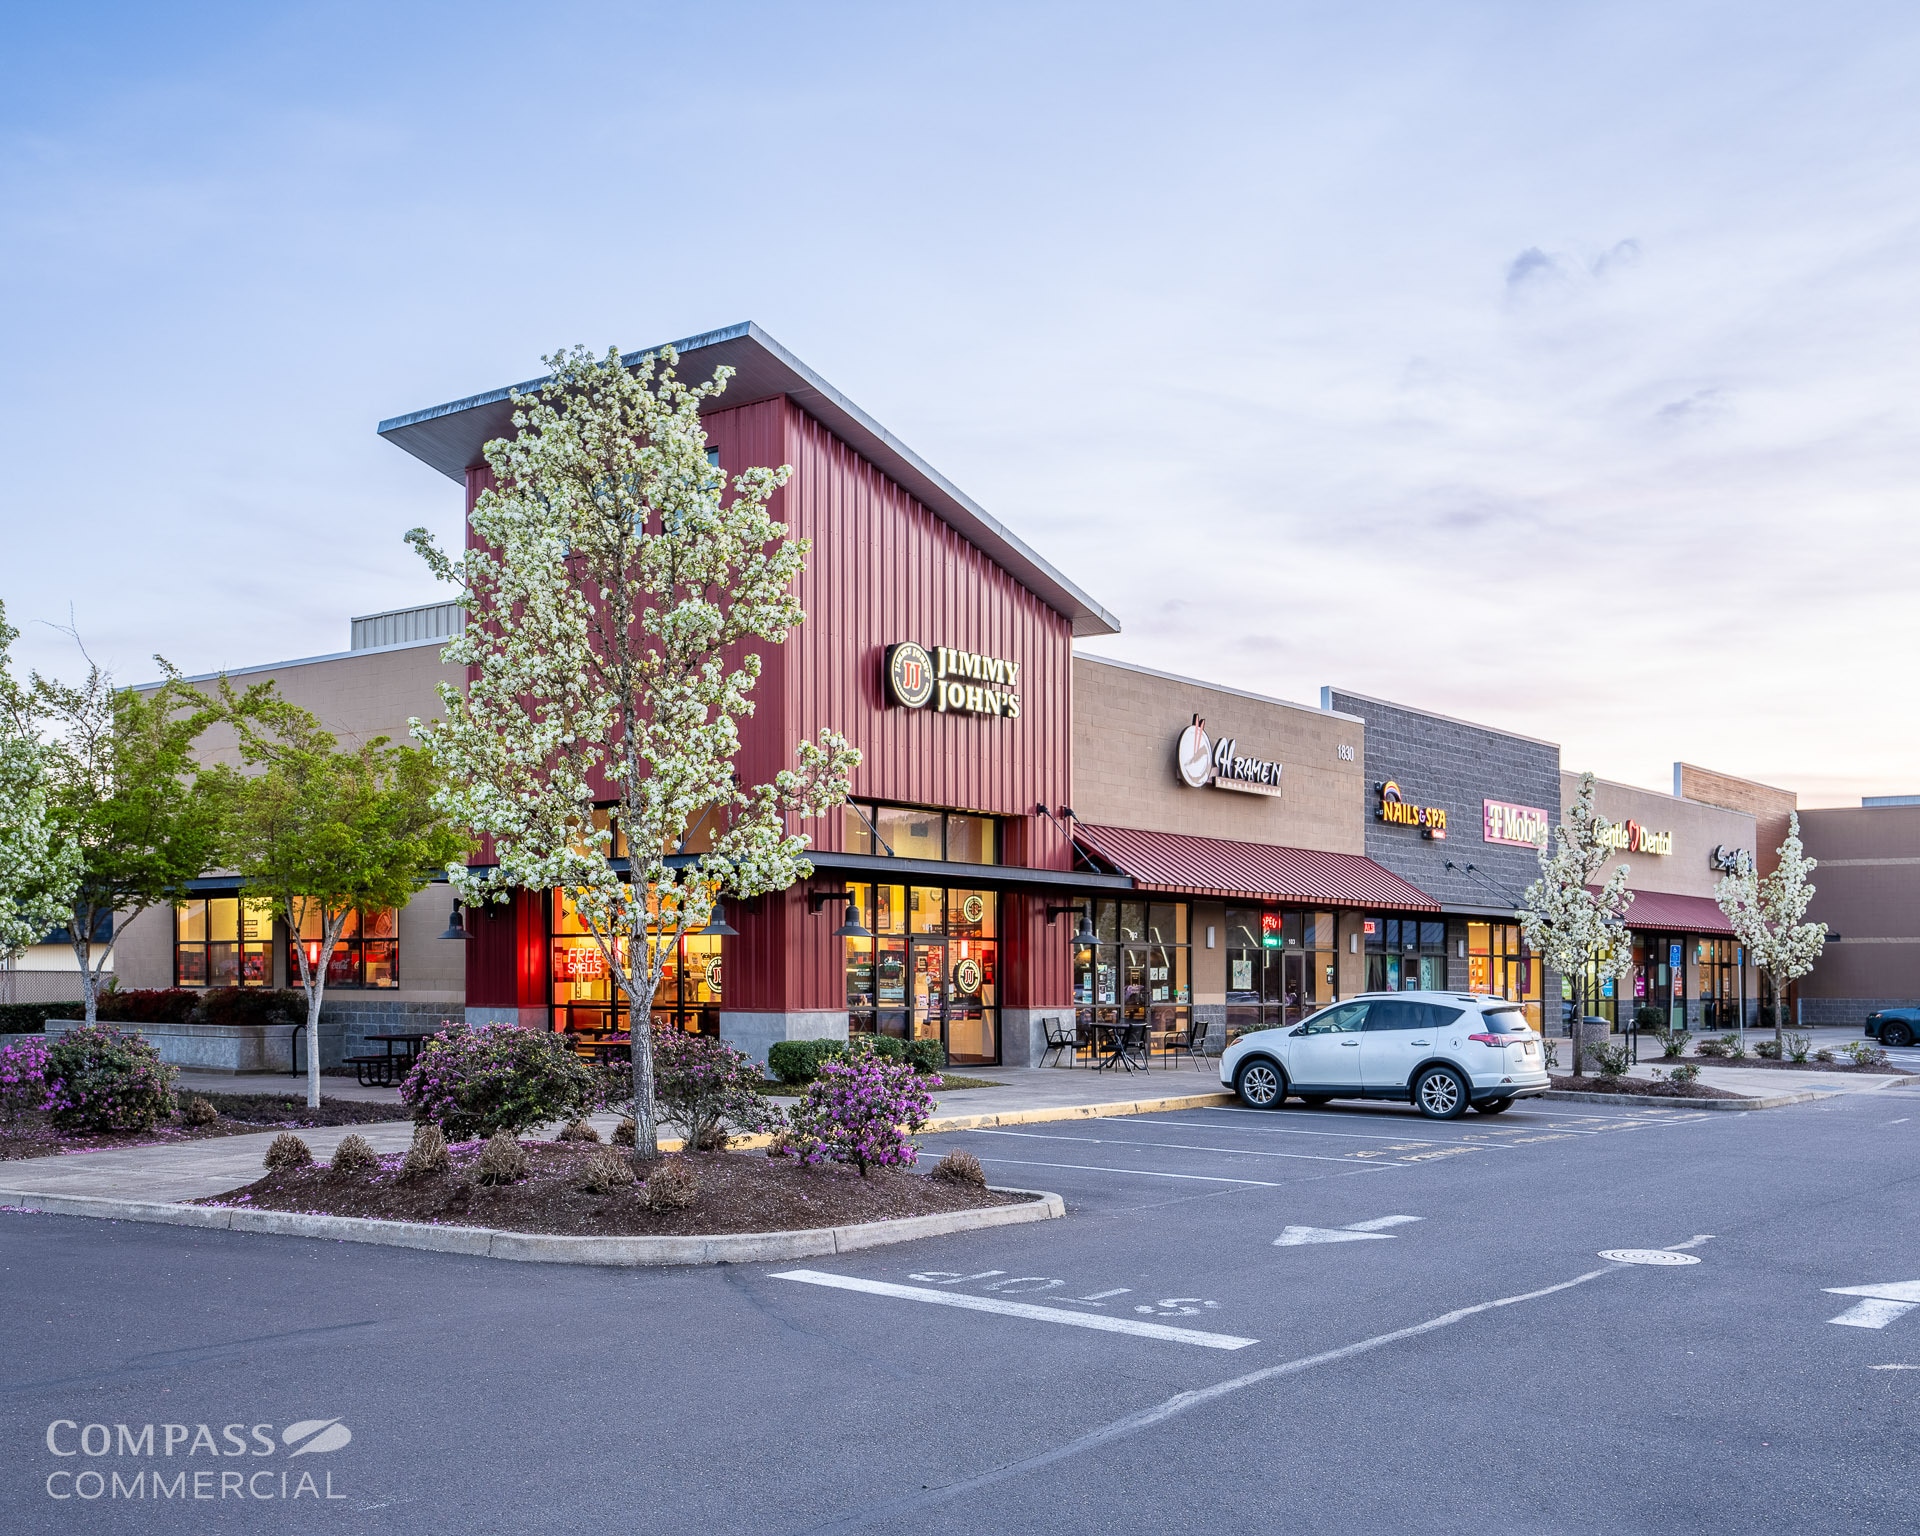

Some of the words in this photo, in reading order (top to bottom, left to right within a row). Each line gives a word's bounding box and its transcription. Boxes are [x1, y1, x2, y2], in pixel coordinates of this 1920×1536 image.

[903, 660, 922, 691] JJ
[937, 646, 1020, 686] JIMMY
[937, 680, 1020, 718] JOHN'S
[1337, 744, 1354, 761] 1830
[1234, 756, 1283, 786] RAMEN
[1383, 801, 1419, 825] NAILS
[1425, 807, 1447, 829] SPA
[1639, 825, 1672, 855] Dental
[567, 947, 602, 963] FREE
[567, 962, 602, 974] SMELLS
